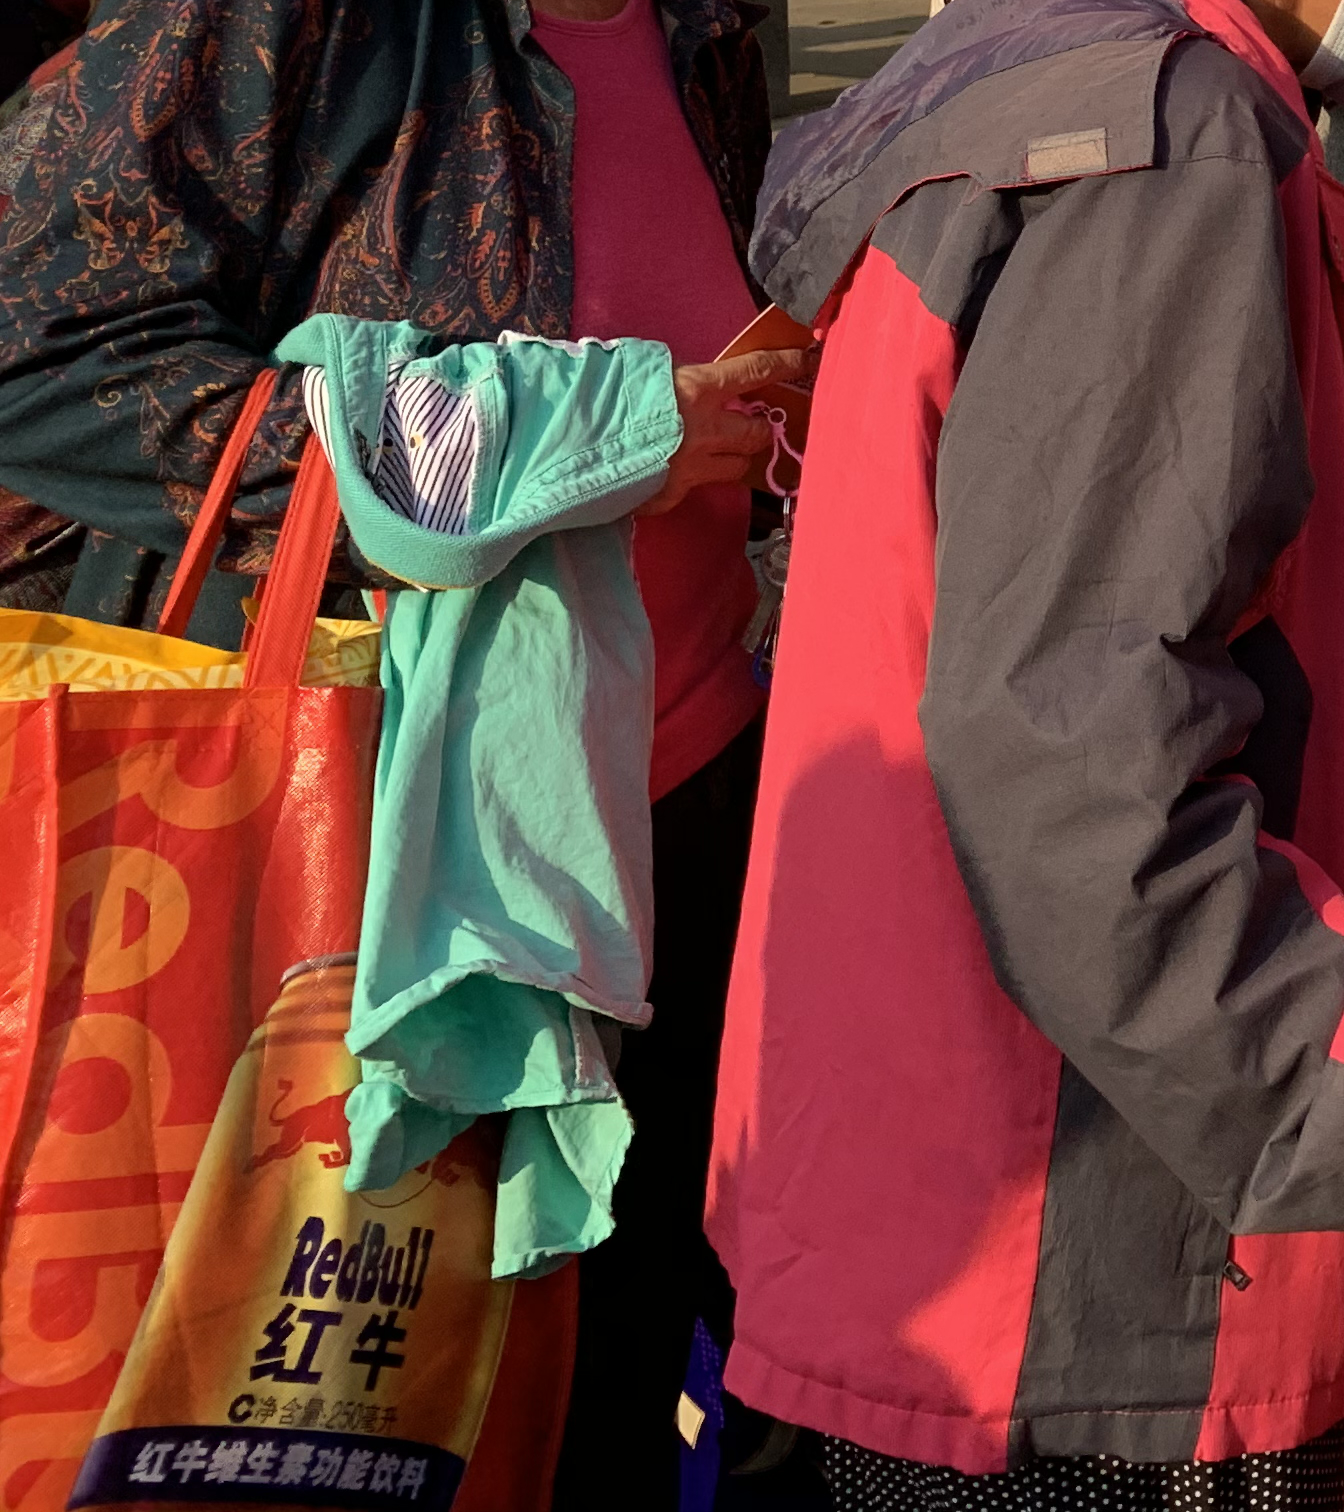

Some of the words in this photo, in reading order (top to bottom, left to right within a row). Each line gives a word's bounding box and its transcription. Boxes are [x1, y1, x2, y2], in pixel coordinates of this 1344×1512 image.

[281, 1216, 434, 1310] RedBull
[249, 1303, 407, 1391] 红牛
[128, 1439, 430, 1500] 红牛维生素功能饮料
